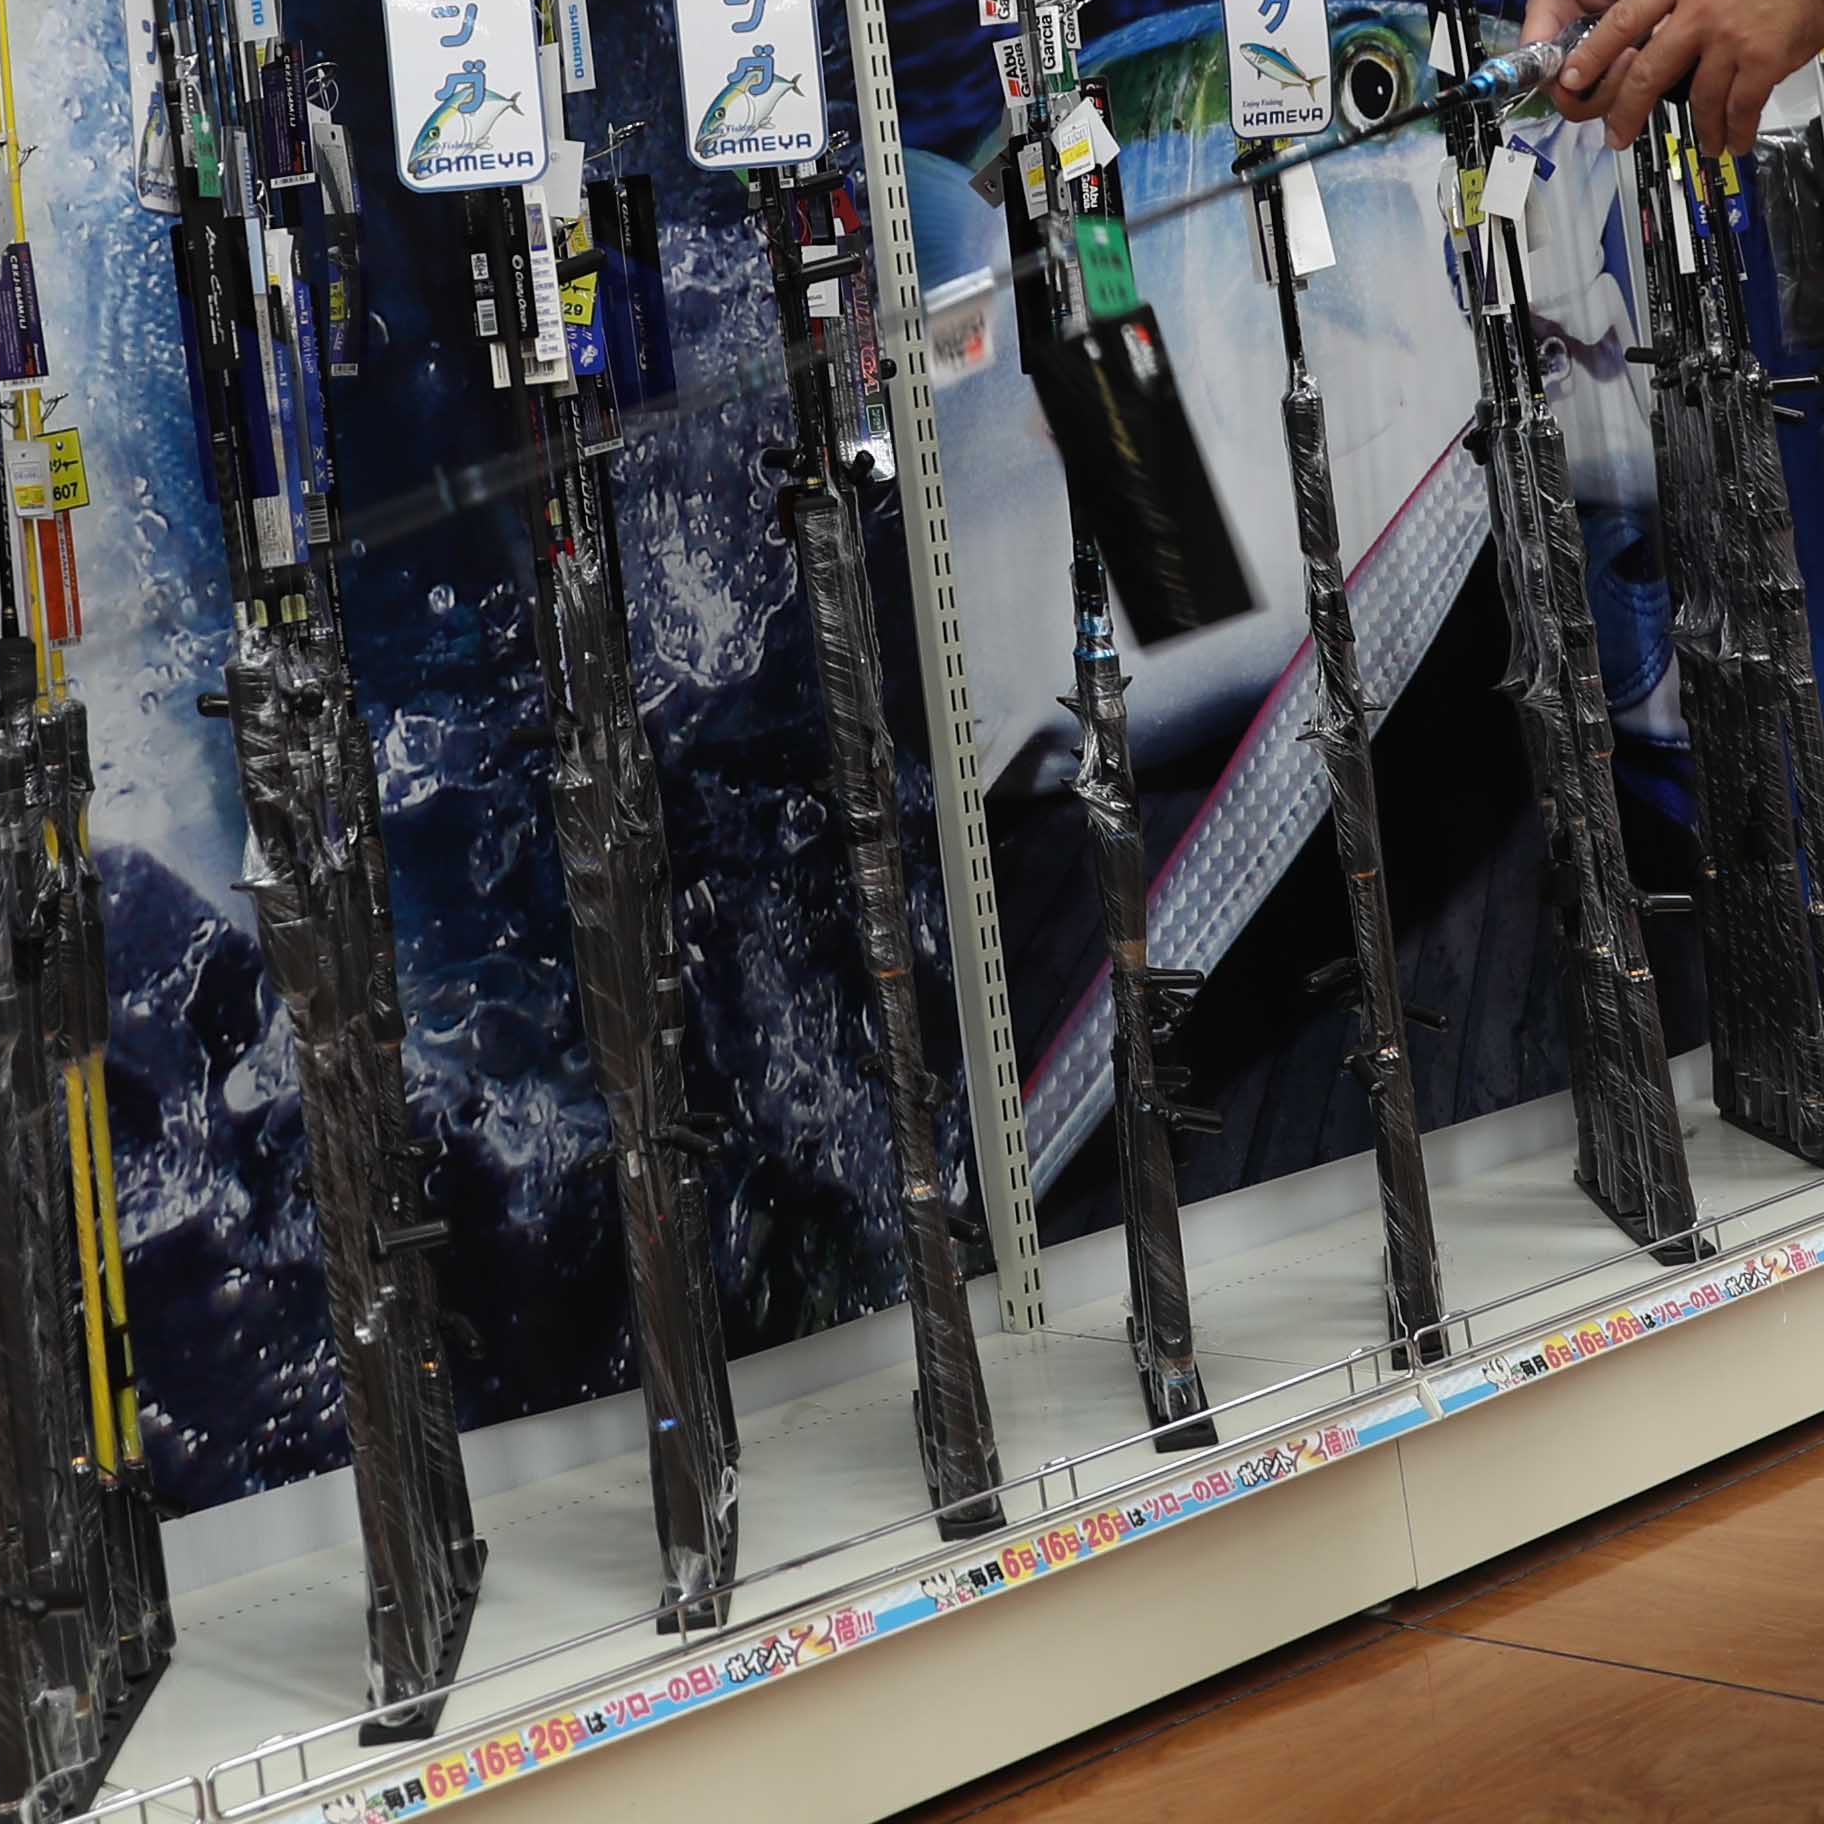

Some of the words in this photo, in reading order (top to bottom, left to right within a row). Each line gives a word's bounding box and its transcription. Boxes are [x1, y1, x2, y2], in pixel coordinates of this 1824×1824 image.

[566, 3, 585, 79] SHIMANO
[1043, 14, 1056, 71] Garcia
[1003, 44, 1019, 79] Abu
[1013, 38, 1031, 98] Garcia
[1242, 106, 1325, 127] KAMEYA
[704, 133, 812, 158] KAMEYA
[416, 150, 534, 174] KAMEYA
[52, 481, 79, 501] 607
